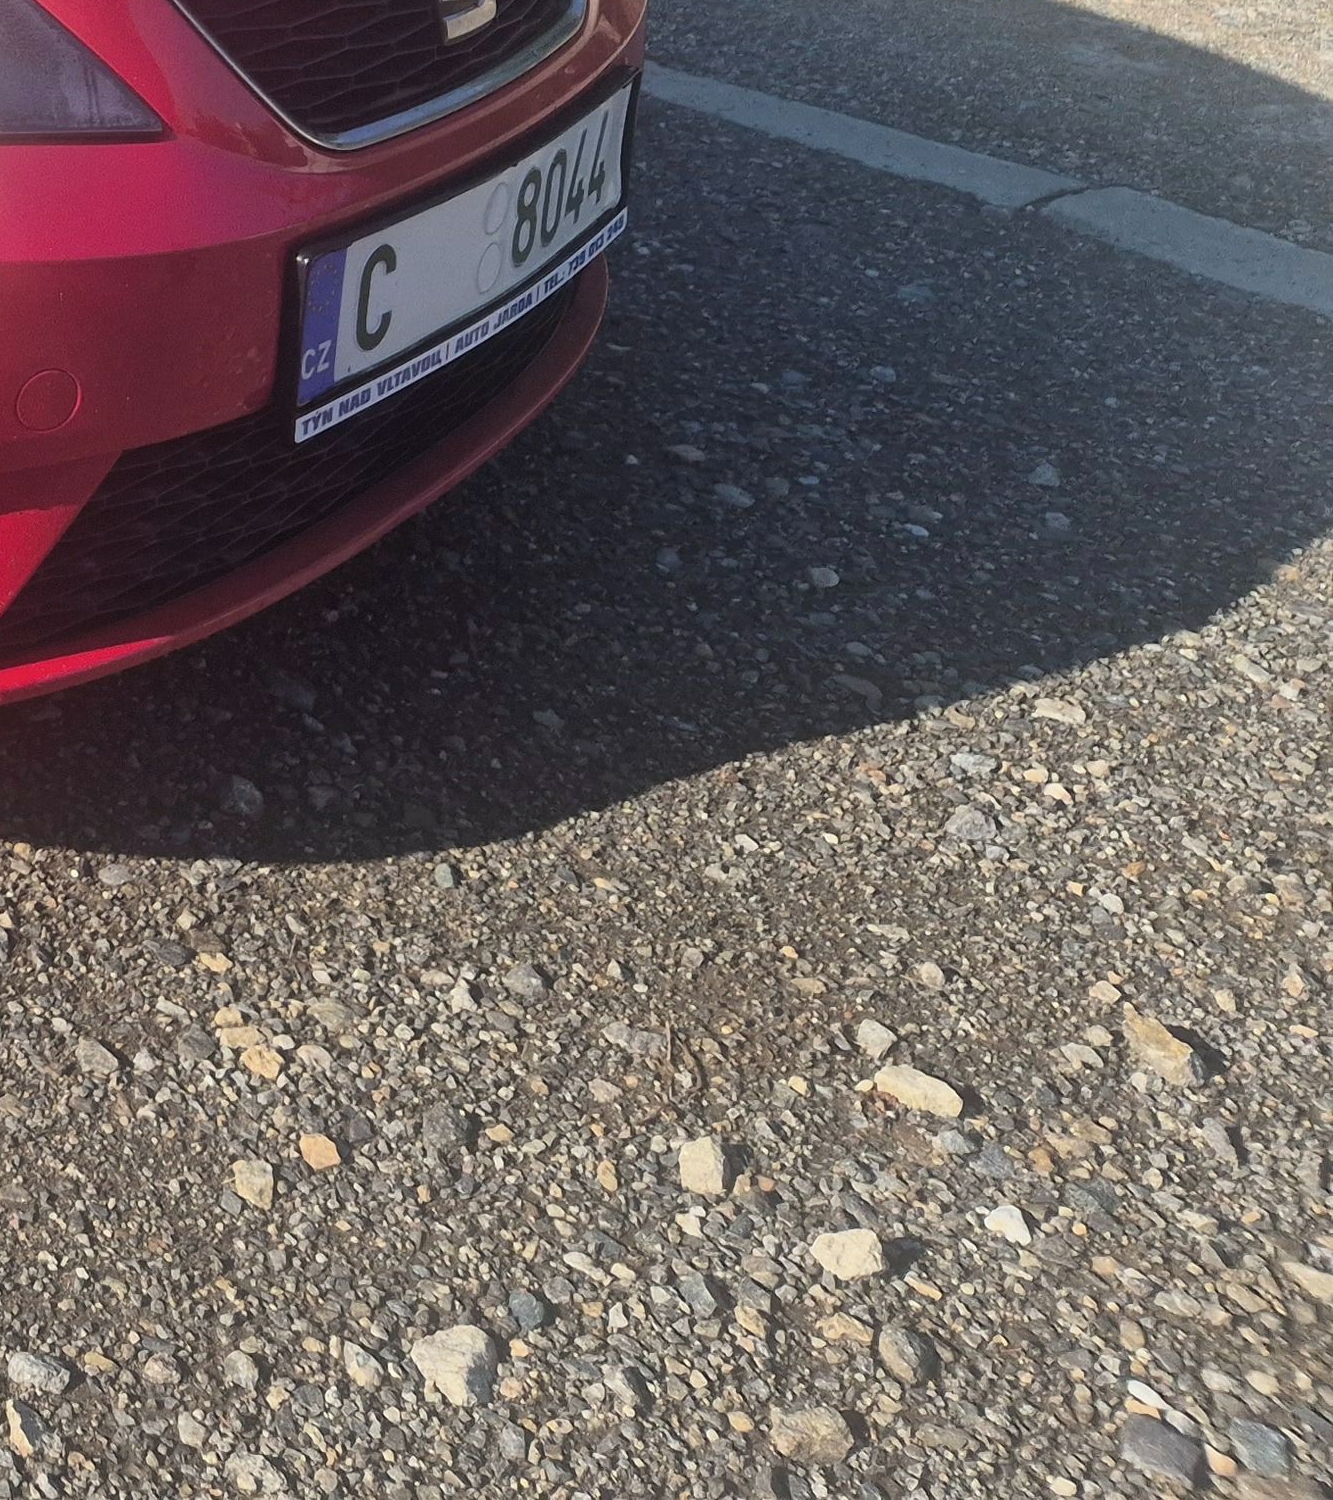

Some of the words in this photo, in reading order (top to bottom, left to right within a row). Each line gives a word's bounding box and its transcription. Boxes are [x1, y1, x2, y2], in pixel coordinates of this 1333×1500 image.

[355, 243, 398, 352] C
[511, 110, 610, 268] 8044
[301, 340, 332, 380] CZ
[301, 407, 333, 436] TÝN
[338, 387, 372, 417] NAD
[454, 321, 490, 354] AUTO
[493, 292, 533, 330] JARDA
